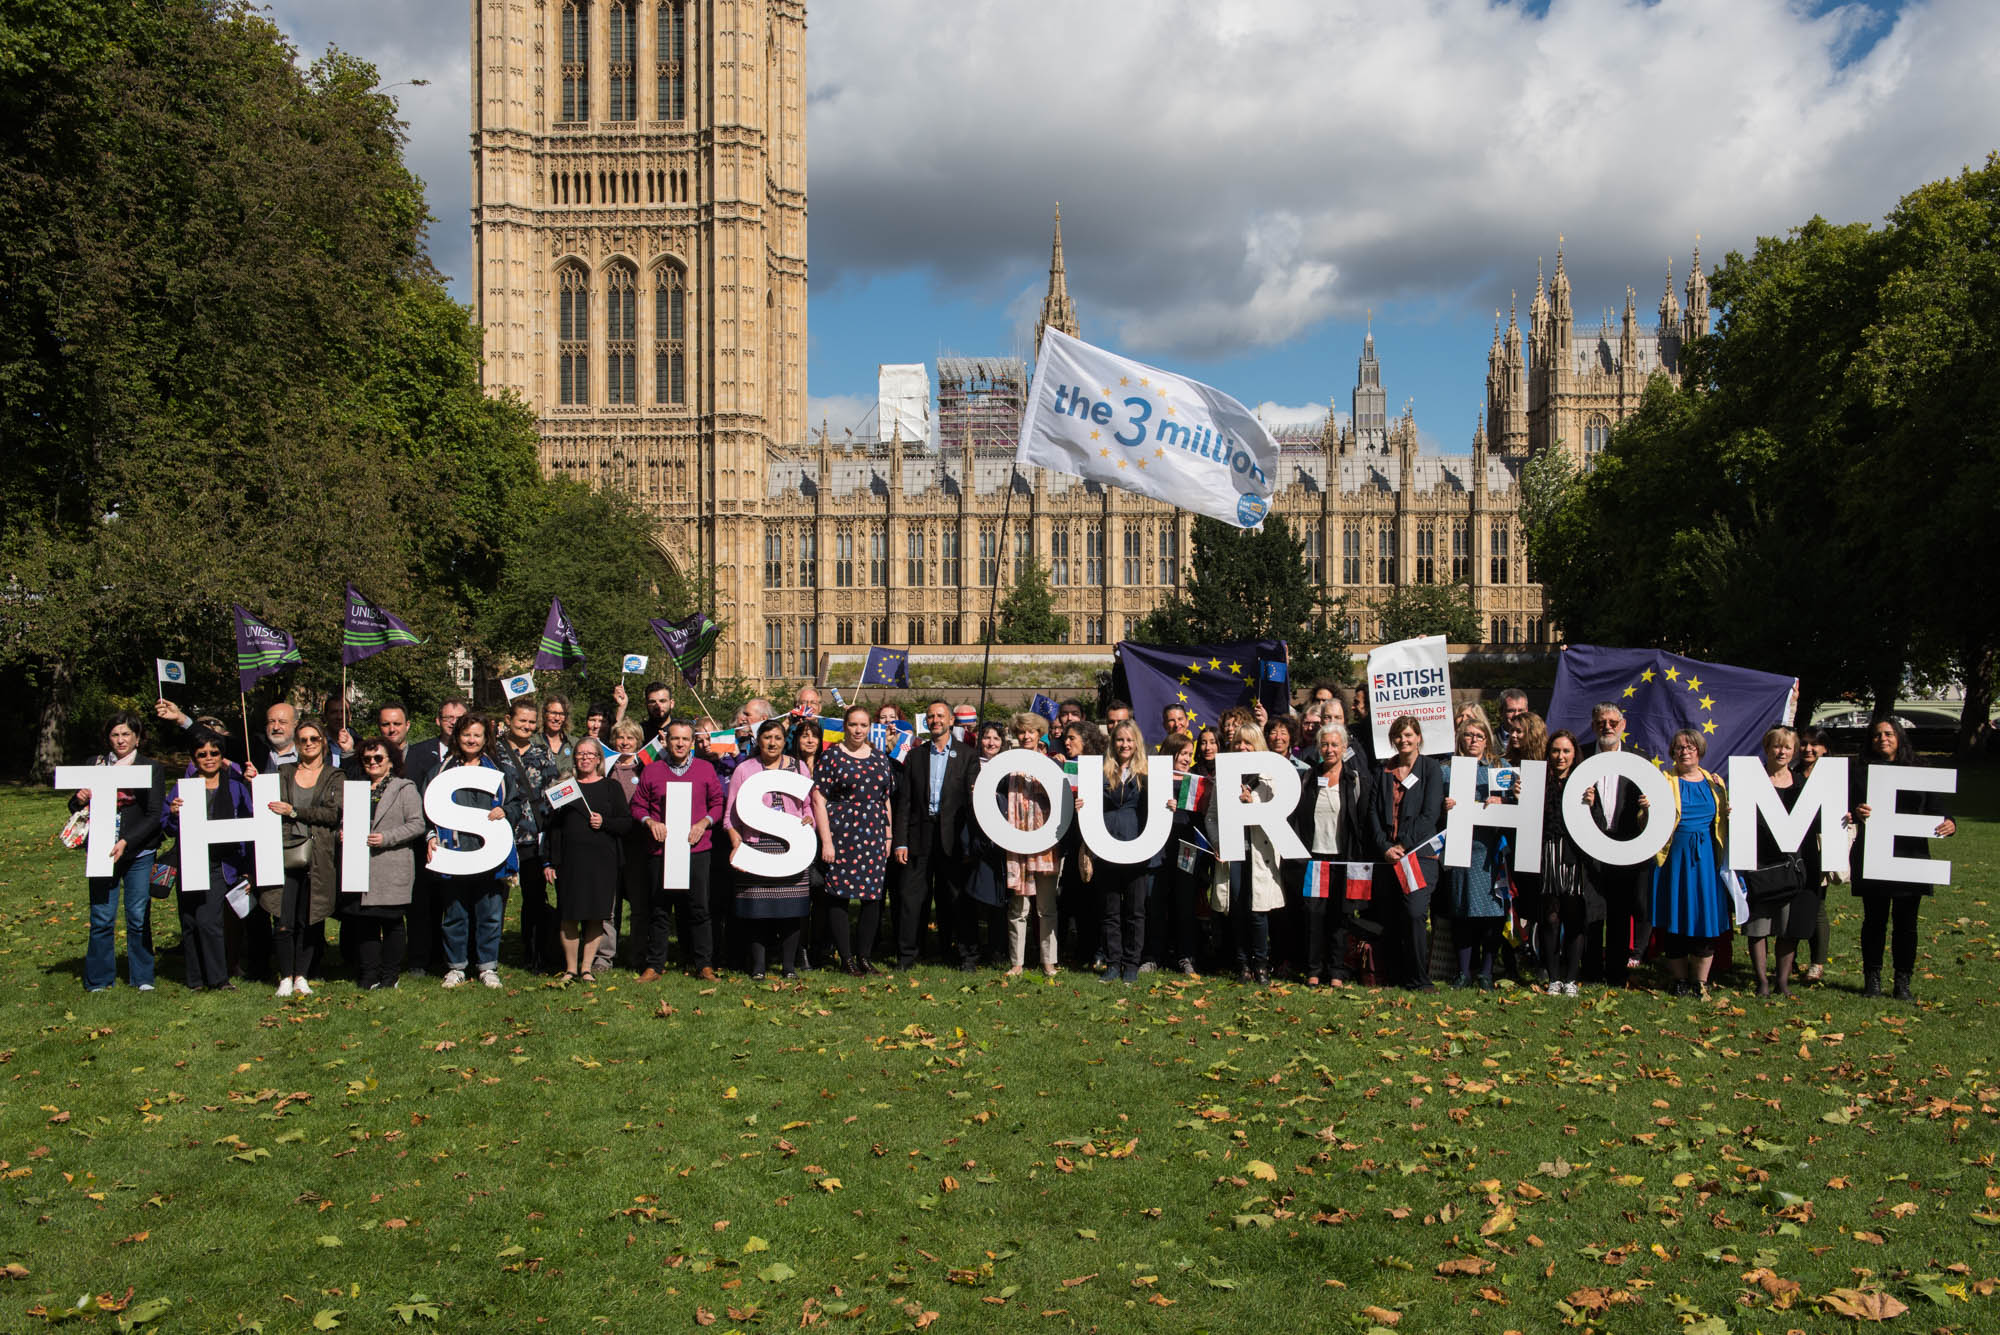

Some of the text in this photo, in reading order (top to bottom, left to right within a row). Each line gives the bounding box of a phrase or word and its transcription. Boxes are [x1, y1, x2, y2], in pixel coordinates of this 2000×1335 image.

[1053, 384, 1266, 485] the 3 million
[1373, 667, 1444, 689] BRITISH
[1375, 685, 1446, 702] IN EUROPE
[1392, 706, 1434, 717] COALITION
[55, 748, 1957, 892] THIS IS OUR HOME
